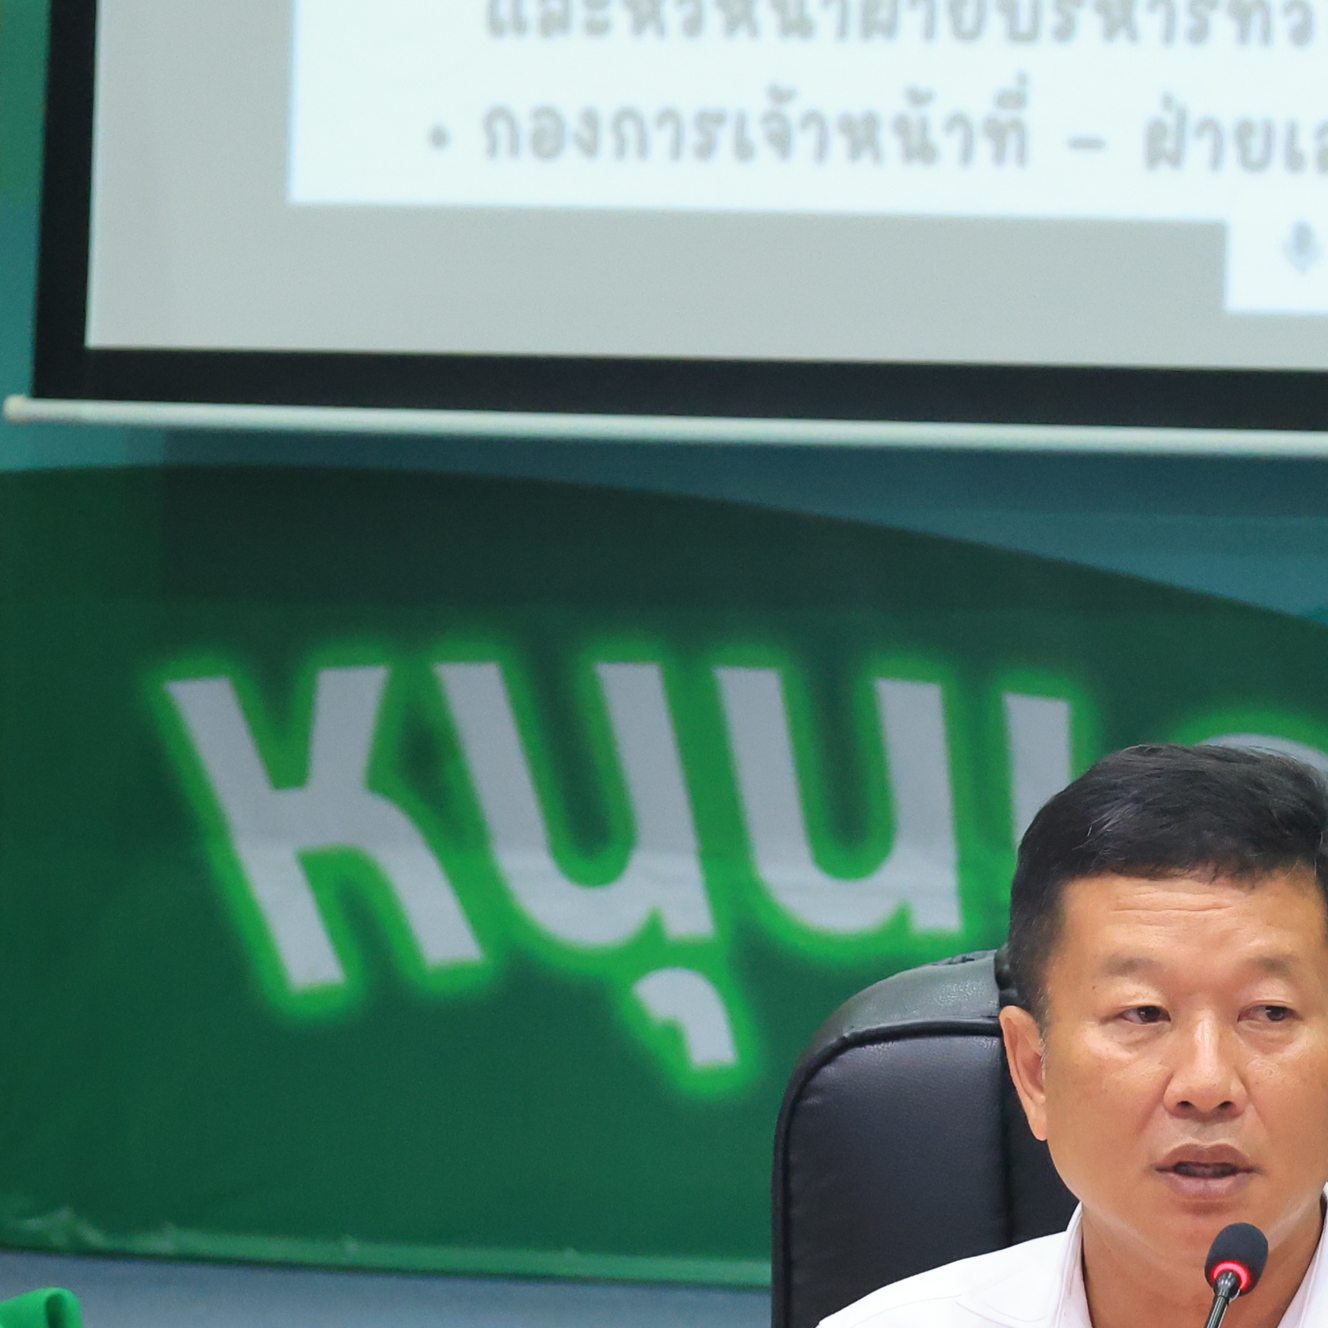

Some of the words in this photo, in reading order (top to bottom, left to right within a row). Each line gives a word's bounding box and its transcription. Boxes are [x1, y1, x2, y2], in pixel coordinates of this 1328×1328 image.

[483, 71, 1028, 168] กองการเจ้าหน้าที่
